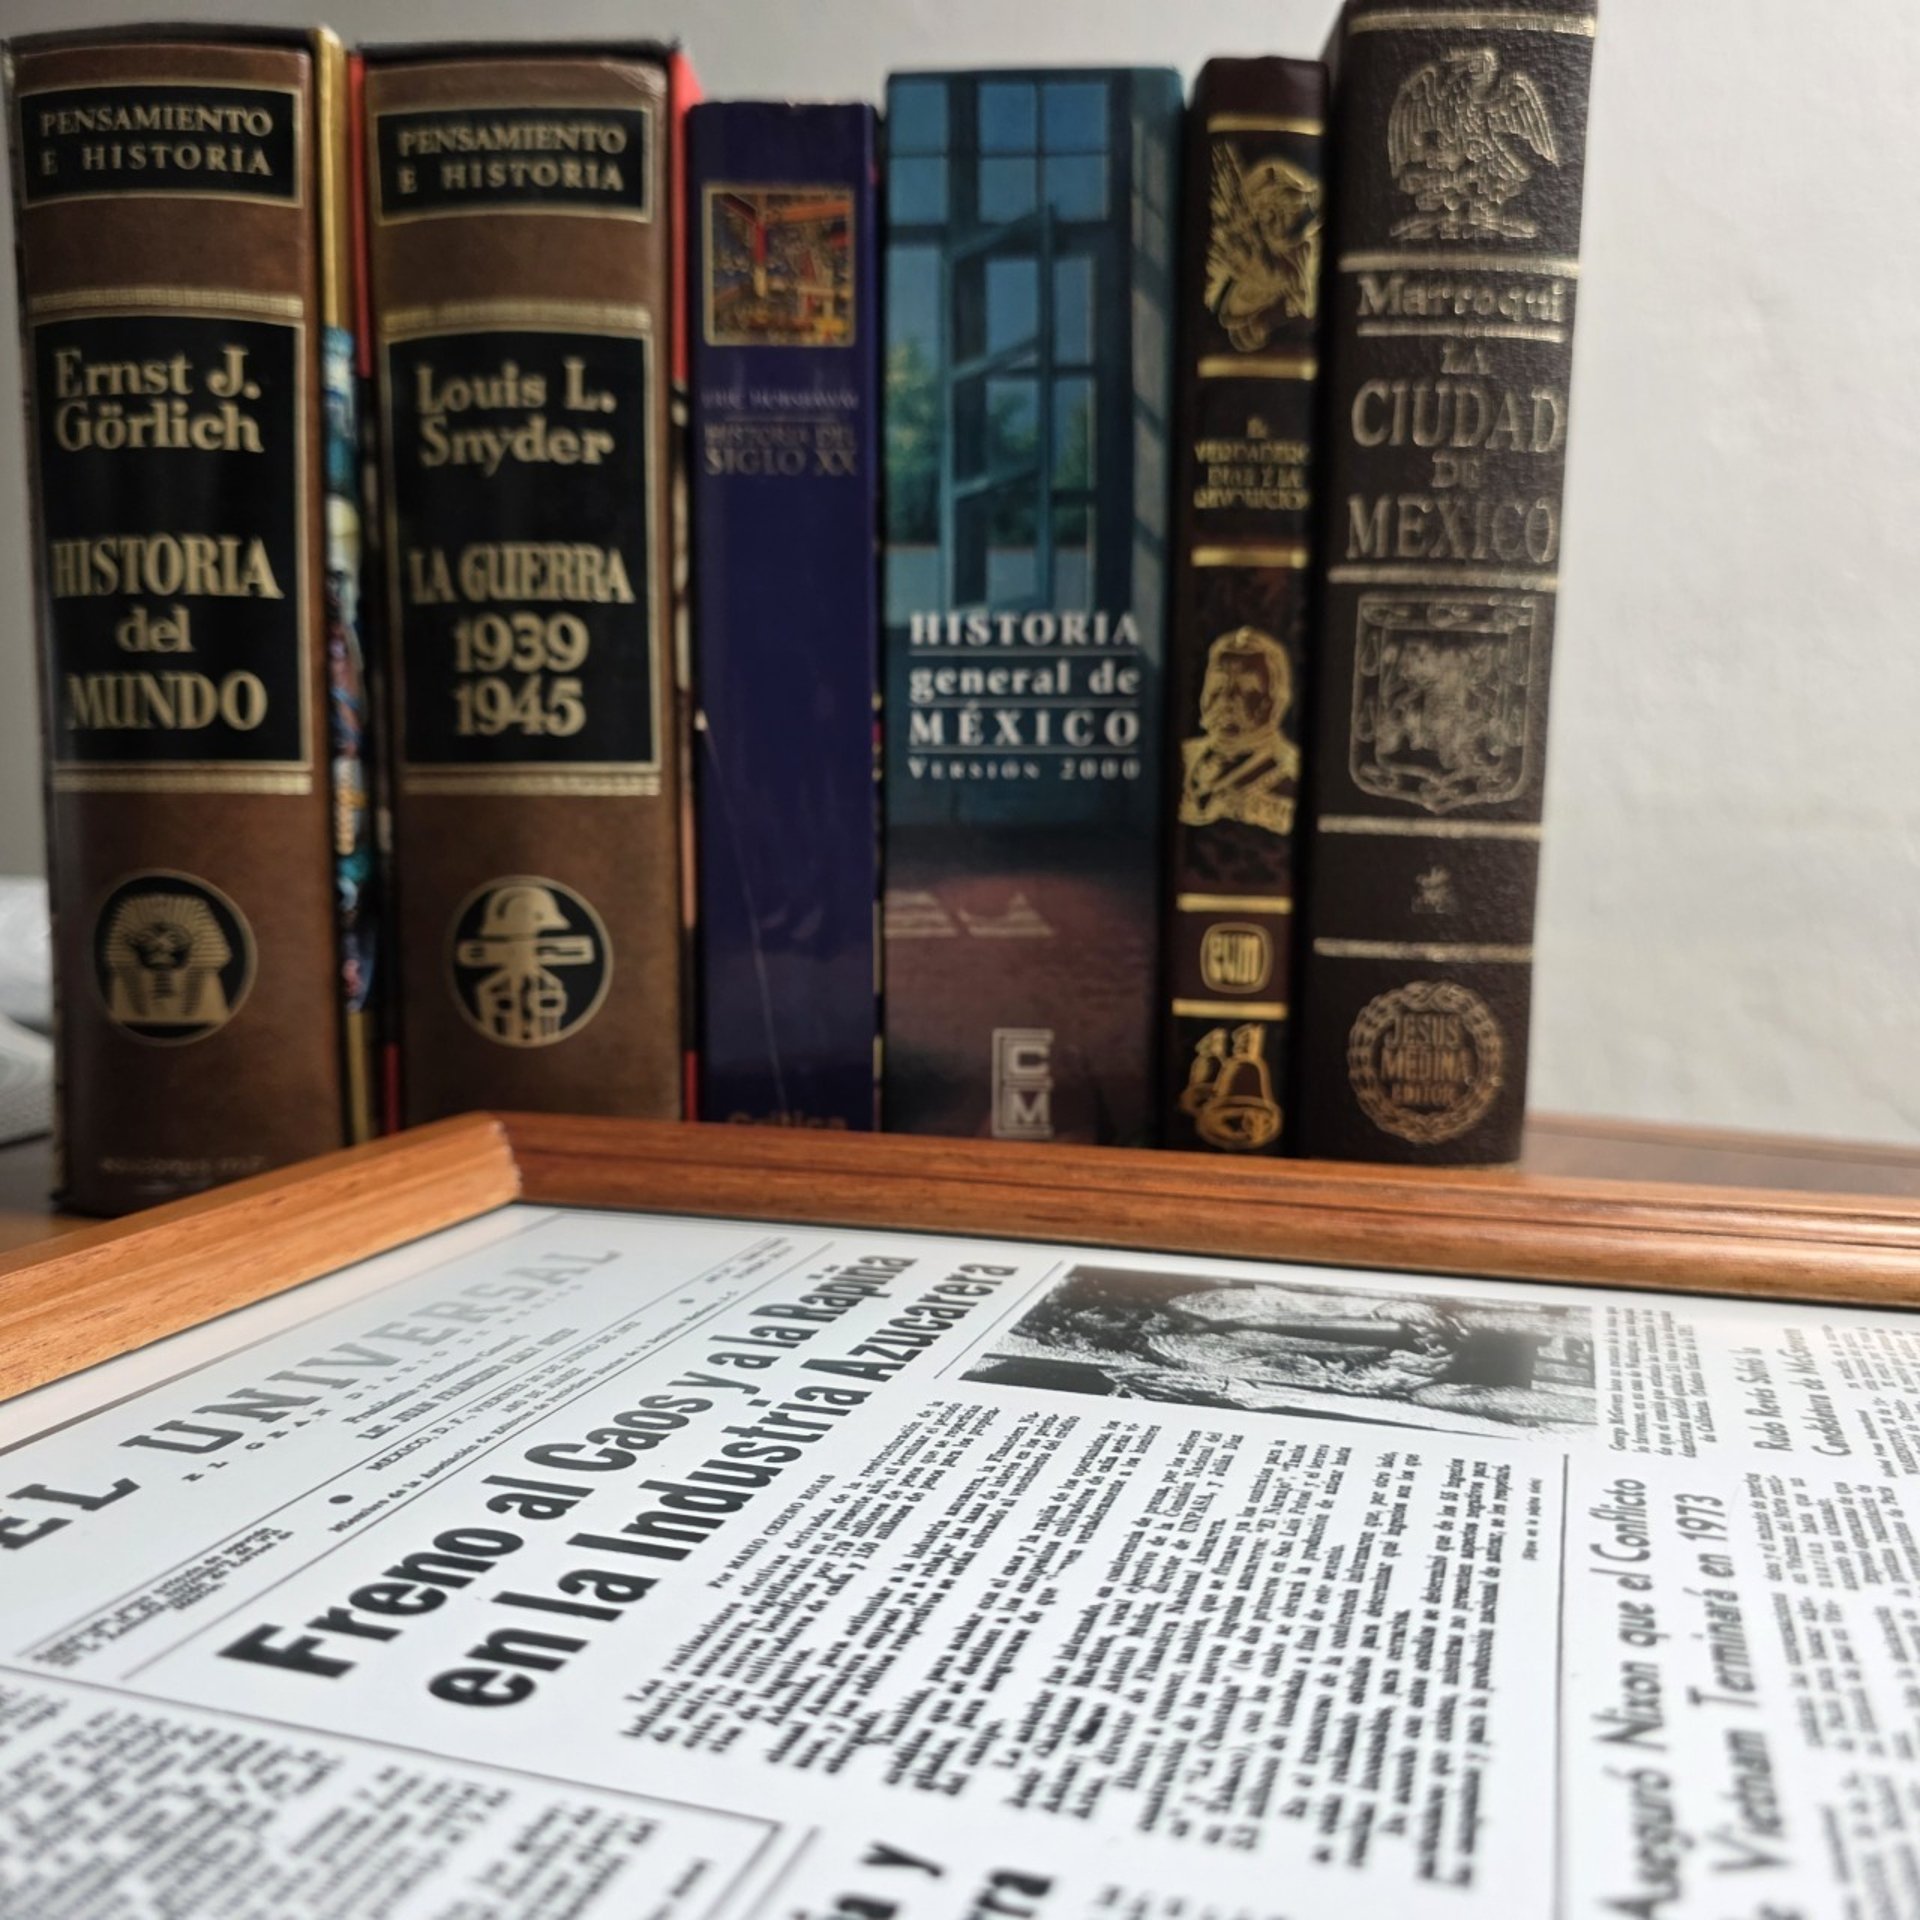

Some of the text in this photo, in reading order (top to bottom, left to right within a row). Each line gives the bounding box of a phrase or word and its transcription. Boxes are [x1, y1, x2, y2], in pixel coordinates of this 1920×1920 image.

[41, 105, 273, 138] PENSAMIENTO
[399, 123, 626, 155] PENSAMIENTO
[41, 144, 273, 176] E HISTORIA
[400, 159, 624, 194] E HISTORIA
[54, 344, 261, 398] Ernst J.
[417, 358, 617, 415] Louis L.
[56, 402, 265, 454] Görlich
[1351, 378, 1567, 453] CIUDAD
[421, 415, 615, 476] Snyder
[1432, 450, 1479, 488] DE
[1346, 493, 1560, 564] MEXICO
[51, 533, 284, 600] HISTORIA
[409, 541, 634, 604] LA GUERRA
[116, 606, 195, 653] del
[455, 612, 590, 673] 1939
[911, 611, 1139, 646] HISTORIA
[65, 670, 268, 732] MUNDO
[455, 678, 588, 736] 1945
[909, 659, 1140, 704] general de
[909, 701, 1139, 746] MÉXICO
[1060, 757, 1140, 780] 2000
[1380, 1045, 1472, 1083] MEDINA
[121, 1253, 616, 1454] UNIVERSAL
[1744, 1387, 1782, 1418] Revés
[1788, 1377, 1826, 1391] de
[365, 1436, 438, 1471] MEXICO,
[429, 1425, 455, 1435] D.
[1749, 1421, 1792, 1451] Rudo
[1802, 1393, 1851, 1456] Candidatura
[221, 1256, 914, 1677] Freno al Caos y a la Rapiña
[428, 1264, 1014, 1707] en la Industria Azucarera
[725, 1537, 768, 1569] MARIO
[762, 1501, 805, 1536] CEDEÑO
[797, 1473, 835, 1500] ROSAS
[740, 1554, 791, 1596] efectivas
[784, 1508, 836, 1549] derivadas
[829, 1493, 850, 1504] de
[841, 1481, 863, 1490] la
[858, 1421, 923, 1477] reestructuración
[755, 1582, 818, 1633] beneficios
[811, 1560, 837, 1580] por
[845, 1502, 891, 1538] millones
[881, 1489, 903, 1500] de
[897, 1466, 925, 1488] pesos
[919, 1449, 939, 1464] que
[933, 1439, 950, 1448] se
[804, 1599, 829, 1613] de
[823, 1572, 854, 1596] caña
[846, 1561, 866, 1571] y
[873, 1504, 914, 1540] millones
[903, 1491, 925, 1502] de
[917, 1468, 946, 1490] pesos
[938, 1449, 963, 1468] para
[951, 1437, 974, 1448] los
[1589, 1478, 1650, 1562] Conflicto
[750, 1557, 814, 1615] significarán
[807, 1543, 828, 1555] en
[820, 1531, 839, 1541] el
[831, 1495, 873, 1531] presente
[865, 1477, 893, 1495] año,
[883, 1466, 900, 1476] al
[1589, 1567, 1653, 1592] el
[1618, 1600, 1669, 1647] que
[1595, 1661, 1664, 1750] Nixon
[1673, 1493, 1786, 1873] Vietnam Terminará en 1973
